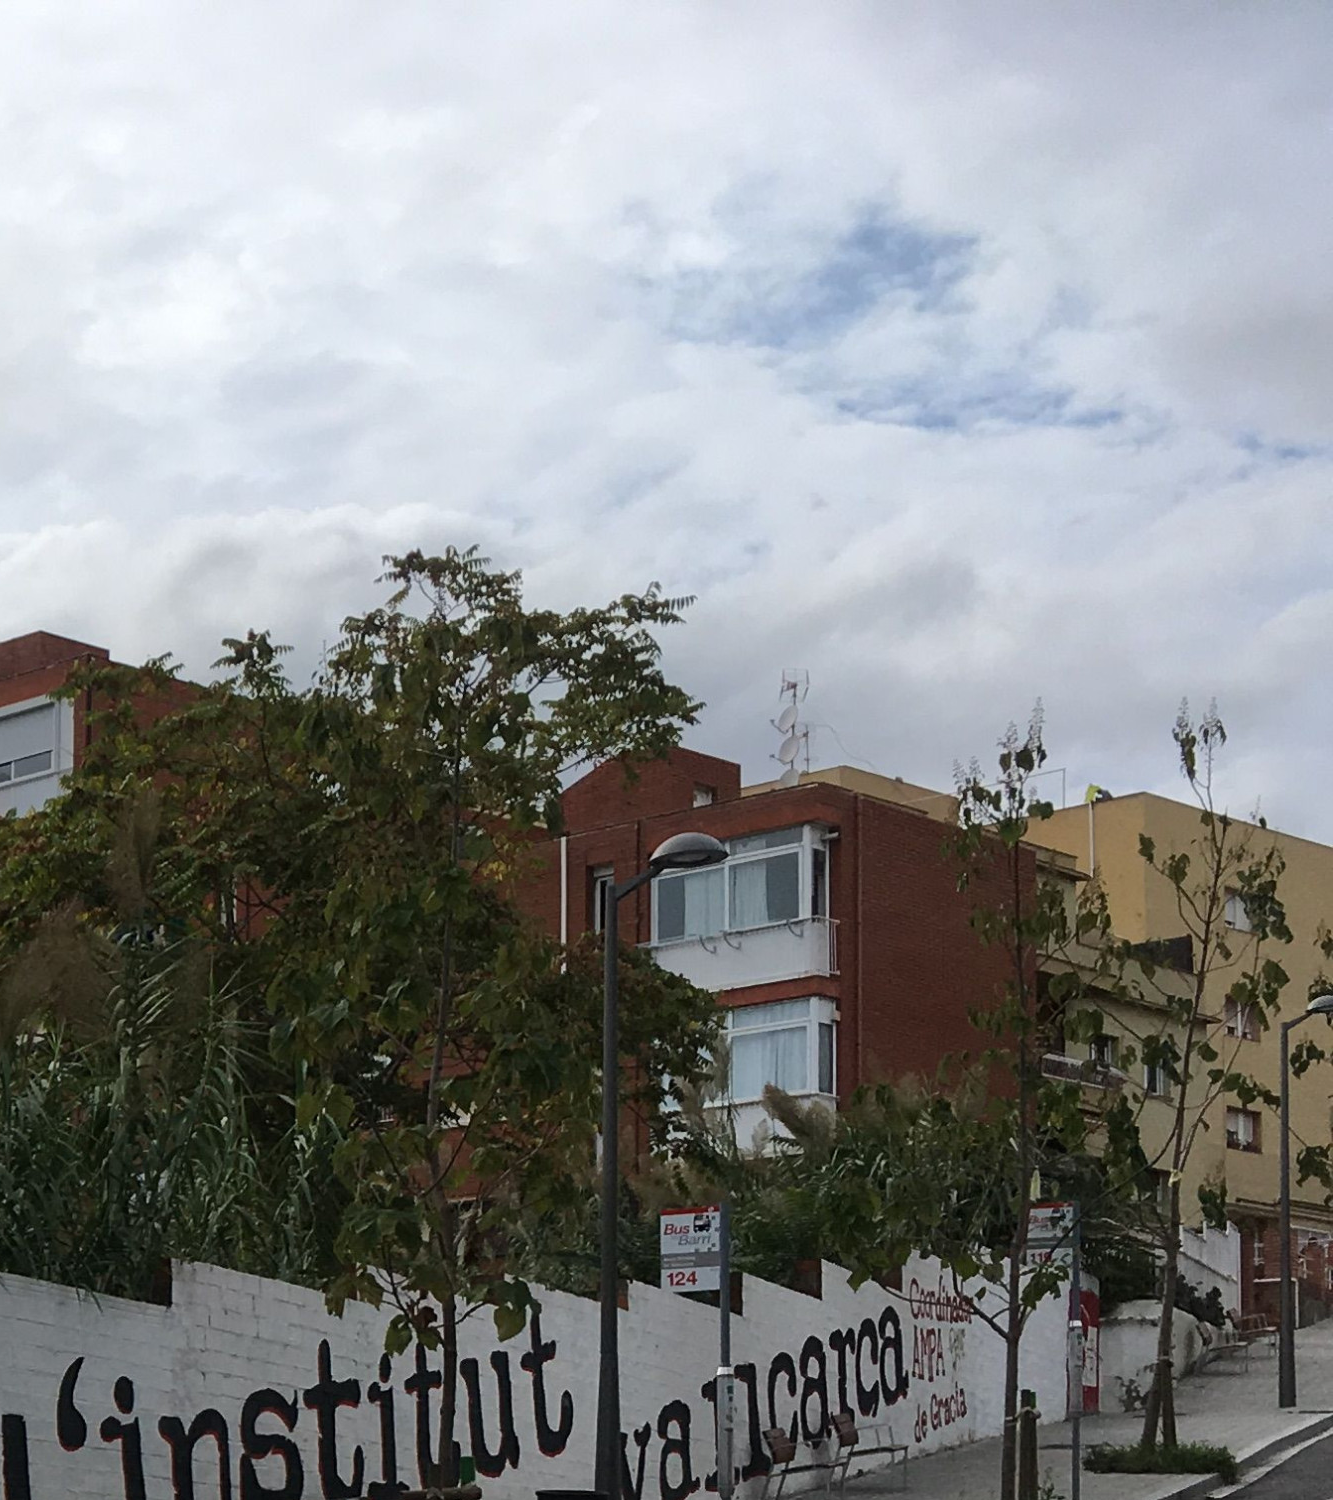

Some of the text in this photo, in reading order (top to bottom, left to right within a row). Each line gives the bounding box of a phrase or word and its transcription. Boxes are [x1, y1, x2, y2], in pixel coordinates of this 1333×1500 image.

[664, 1223, 690, 1236] Bus
[666, 1270, 698, 1287] 124
[912, 1324, 946, 1382] AMPA
[914, 1403, 928, 1443] de
